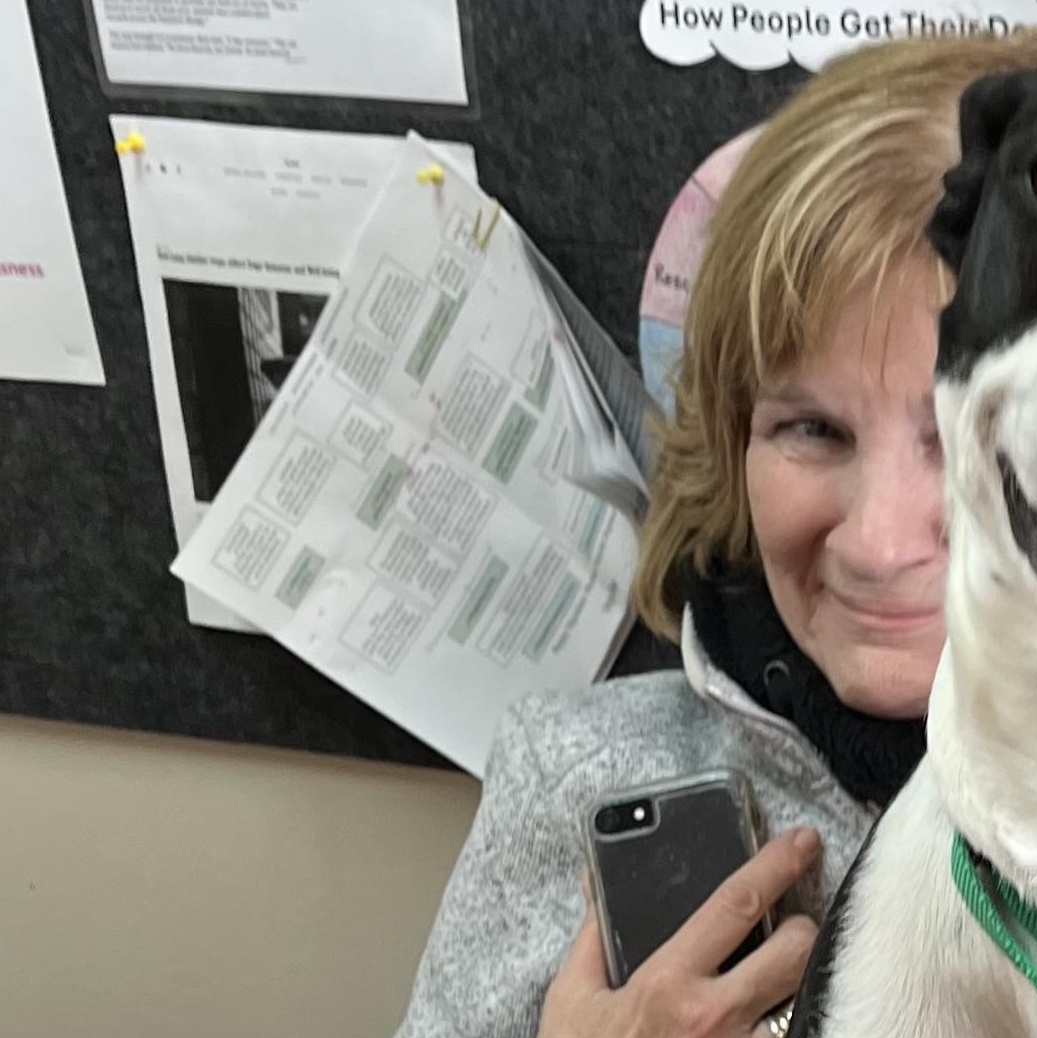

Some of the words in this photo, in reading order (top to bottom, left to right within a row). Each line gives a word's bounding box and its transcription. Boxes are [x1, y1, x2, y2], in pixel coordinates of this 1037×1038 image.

[660, 2, 723, 29] How
[731, 3, 831, 39] People
[841, 9, 892, 38] Get
[902, 10, 979, 38] Their
